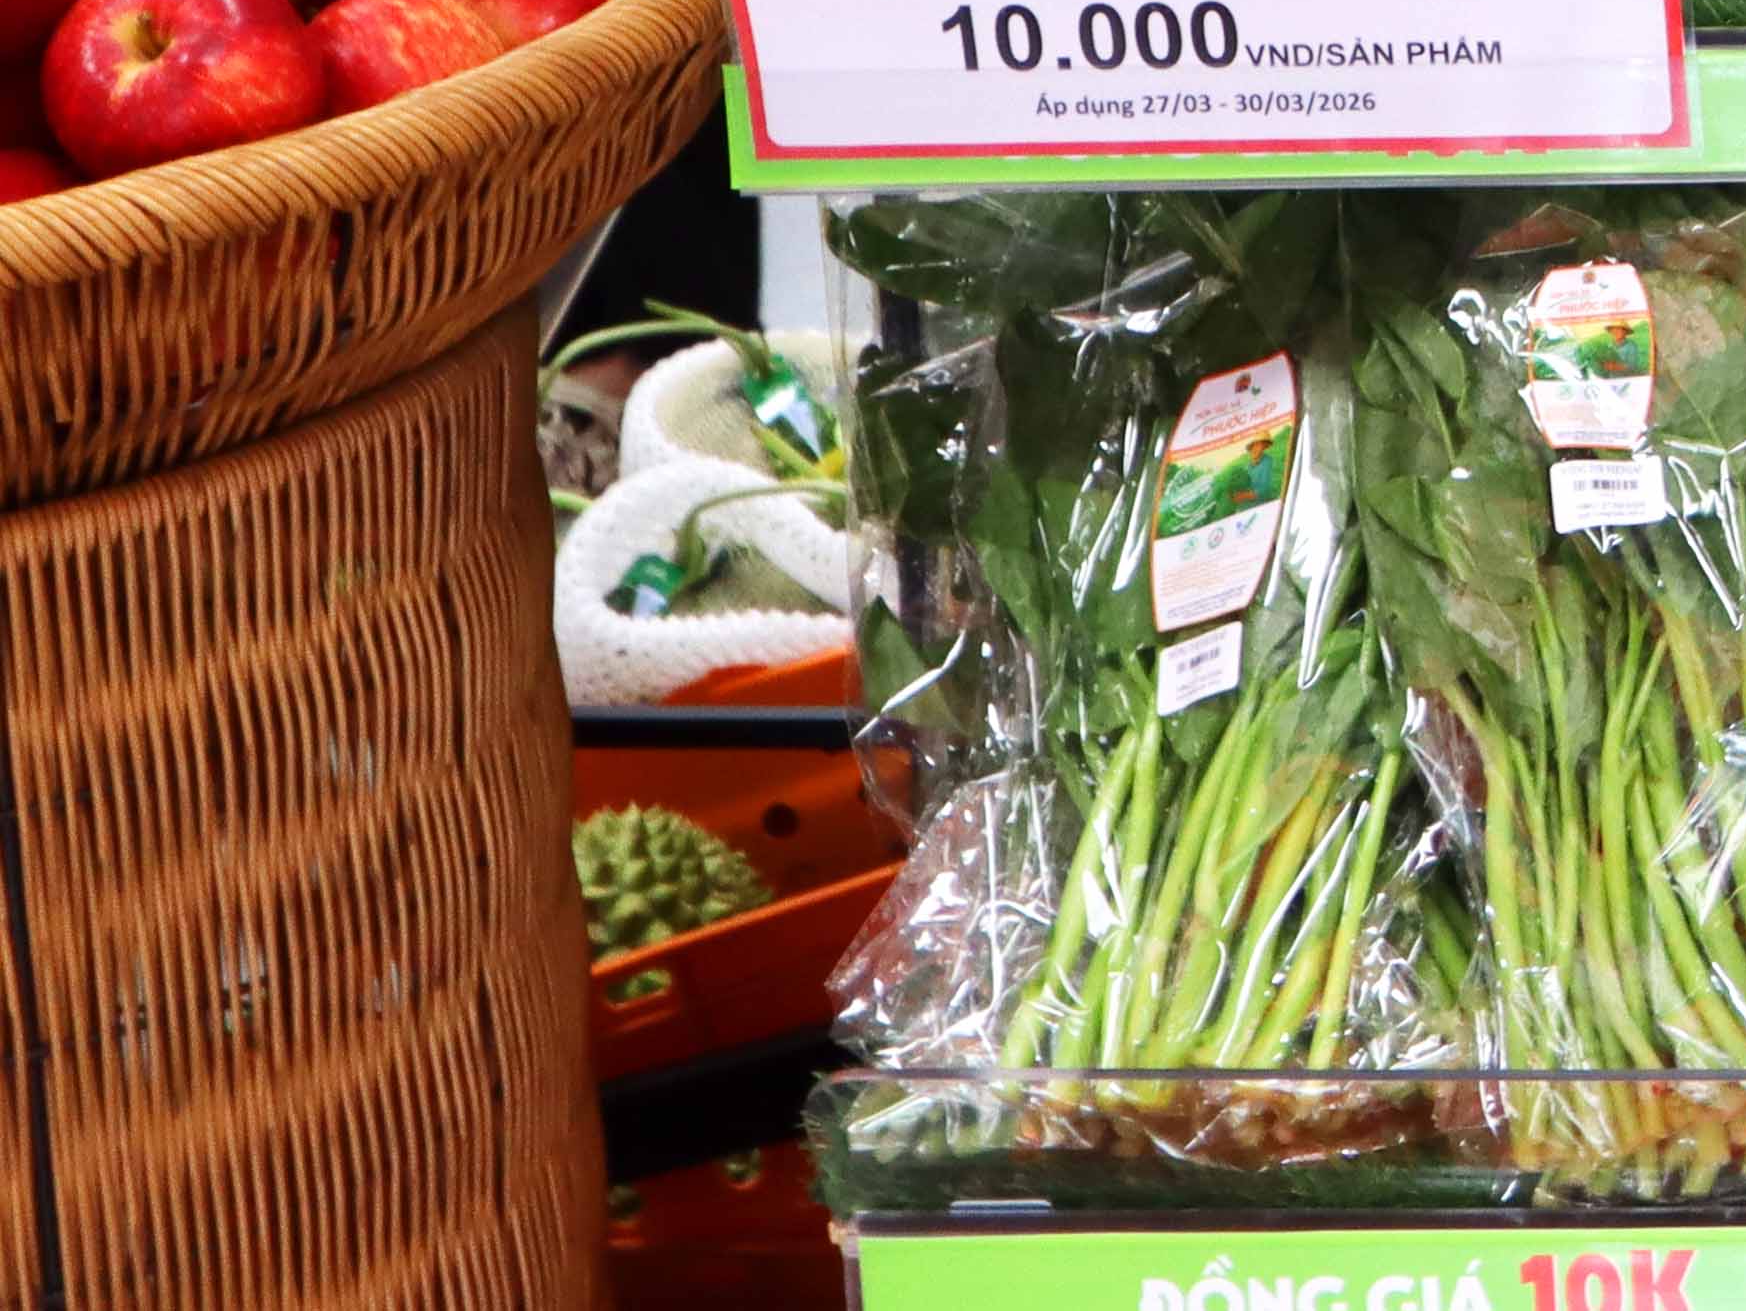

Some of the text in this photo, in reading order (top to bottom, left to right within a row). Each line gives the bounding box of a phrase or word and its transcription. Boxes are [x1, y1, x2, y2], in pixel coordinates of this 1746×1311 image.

[940, 0, 1239, 74] 10.000
[1244, 38, 1395, 68] VND/SẢN
[1035, 91, 1068, 119] Áp
[1074, 95, 1136, 118] dụng
[1141, 92, 1213, 117] 27/03
[1234, 89, 1377, 116] 30/03/2026
[1139, 1248, 1697, 1311] ĐỒNG GIÁ 10K
